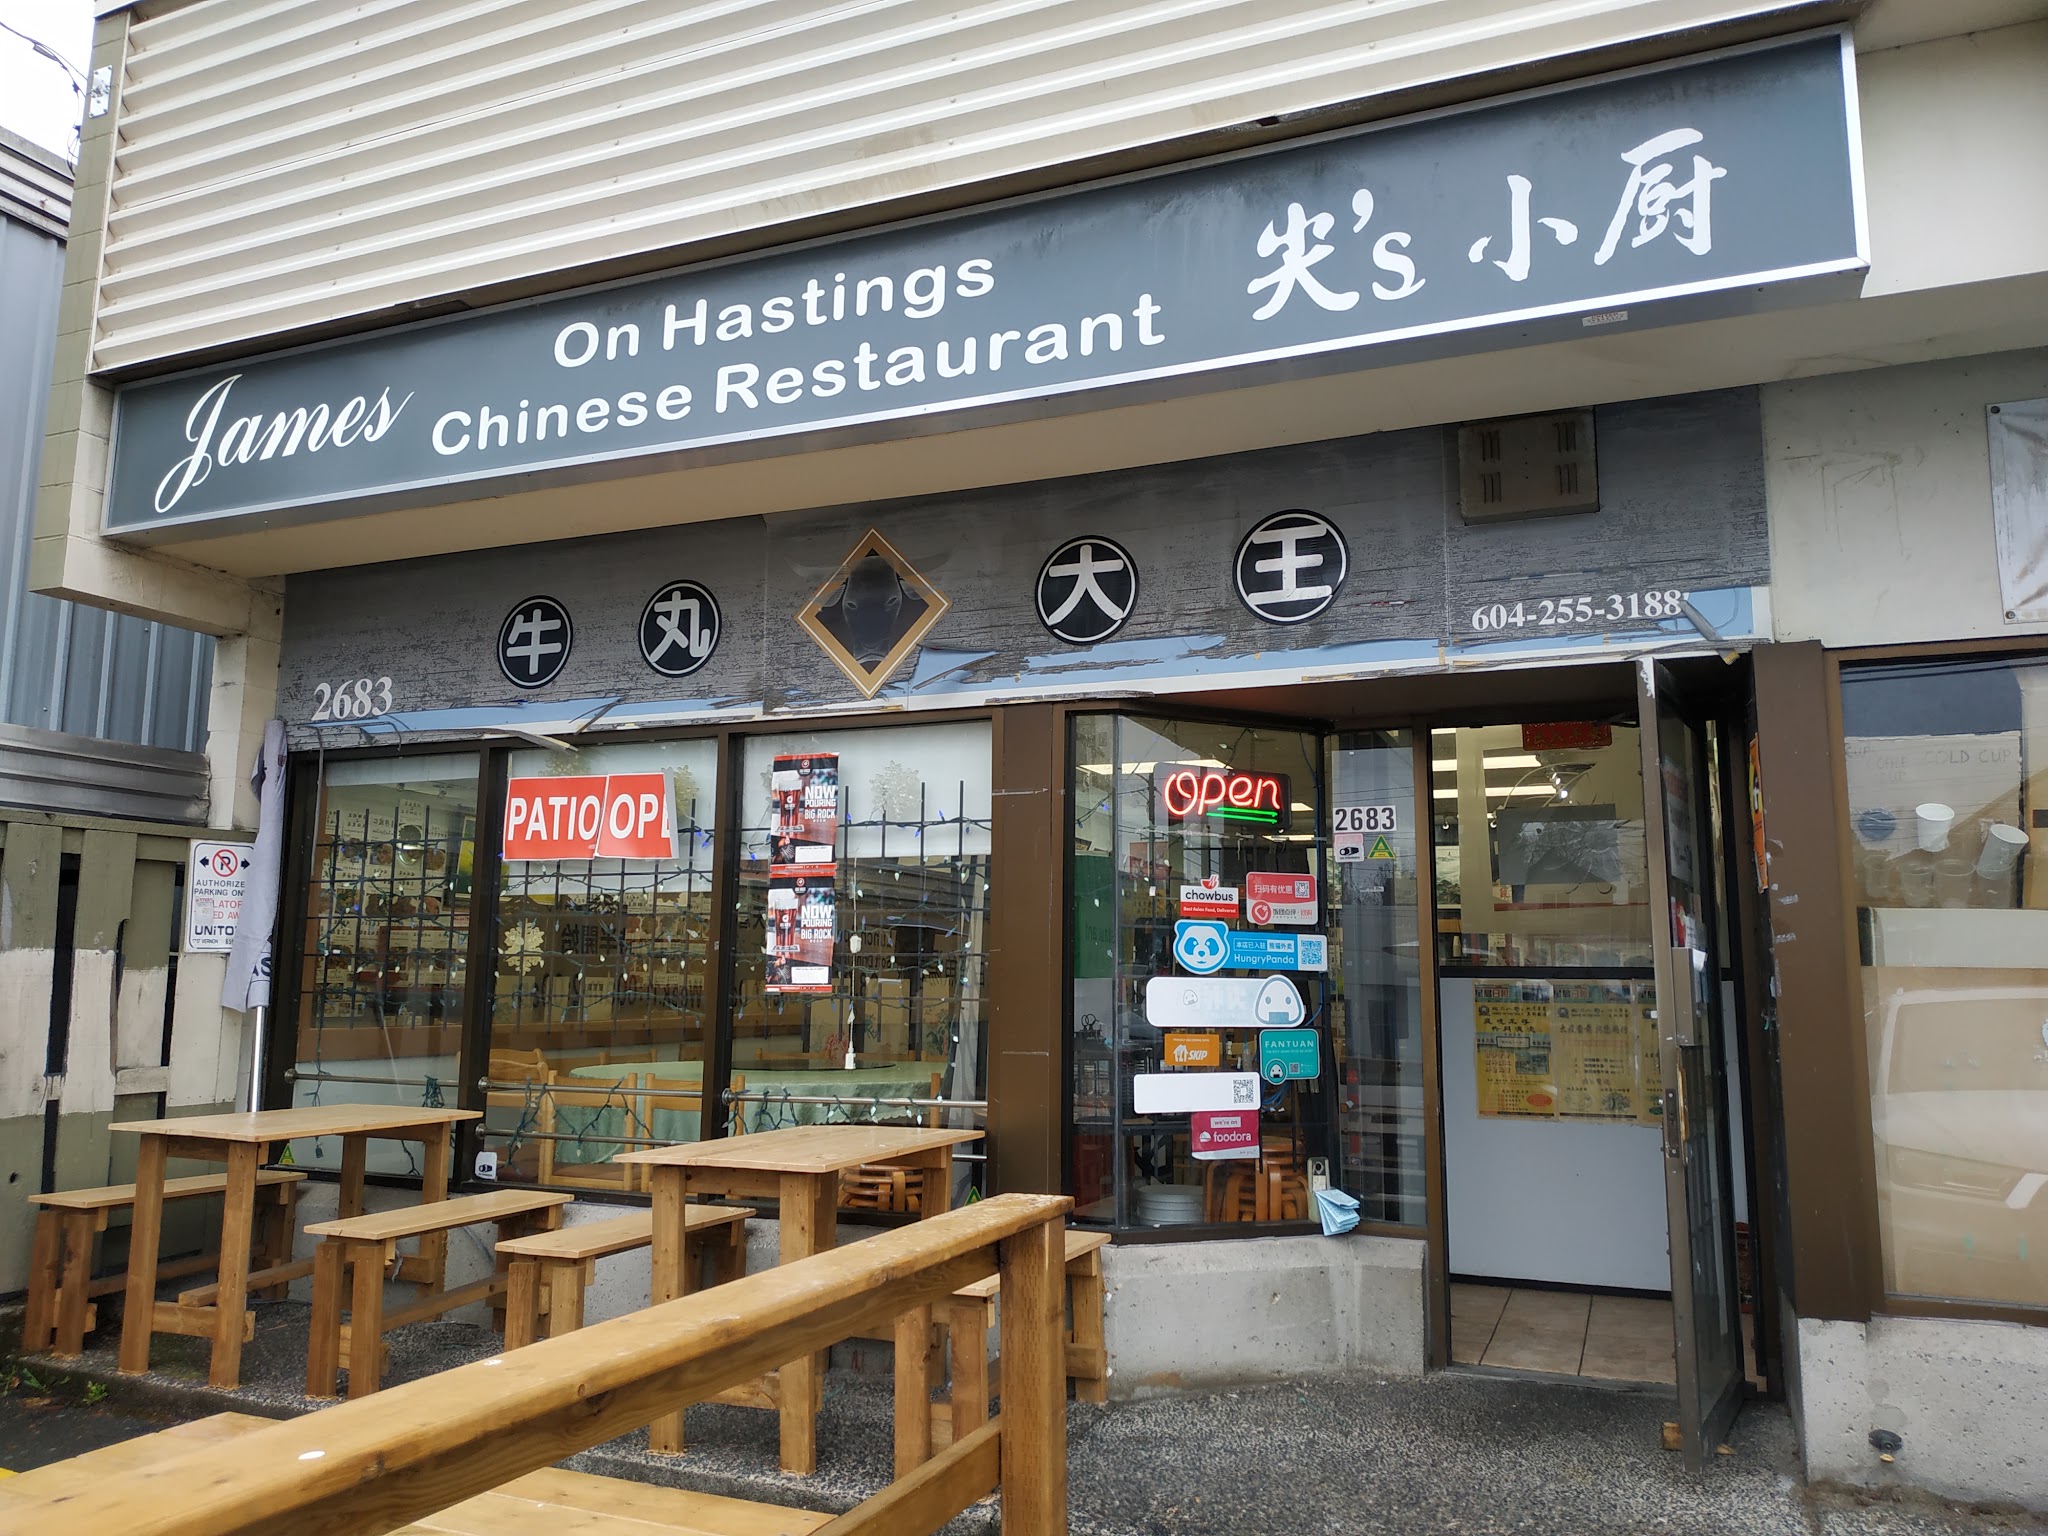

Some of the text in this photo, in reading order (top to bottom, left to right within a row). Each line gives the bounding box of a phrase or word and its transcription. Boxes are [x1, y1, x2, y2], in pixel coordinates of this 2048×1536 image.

[553, 257, 996, 368] On Hastings
[431, 293, 1166, 456] Chinese Restaurant
[153, 373, 416, 513] James
[506, 523, 1332, 676] 牛 丸 大 王
[1472, 589, 1682, 631] 604-255-3188
[310, 676, 394, 722] 2683
[804, 785, 837, 799] NOW
[804, 798, 837, 808] POURING
[507, 795, 601, 841] PATIO
[804, 808, 836, 820] BIG ROCK
[1335, 807, 1395, 831] 2683
[196, 879, 246, 888] AUTHORIZE
[1253, 883, 1293, 895] 扫码有优惠
[194, 888, 229, 896] PARKING
[1185, 889, 1234, 902] chowbus
[801, 905, 833, 919] NOW
[801, 918, 833, 928] POURING
[194, 925, 237, 936] UNiTO
[801, 928, 832, 940] BIG ROCK
[1234, 954, 1295, 965] HungryPanda
[1264, 1040, 1315, 1048] FANTUAN
[1188, 1050, 1208, 1061] SKIP
[1213, 1131, 1252, 1142] foodora
